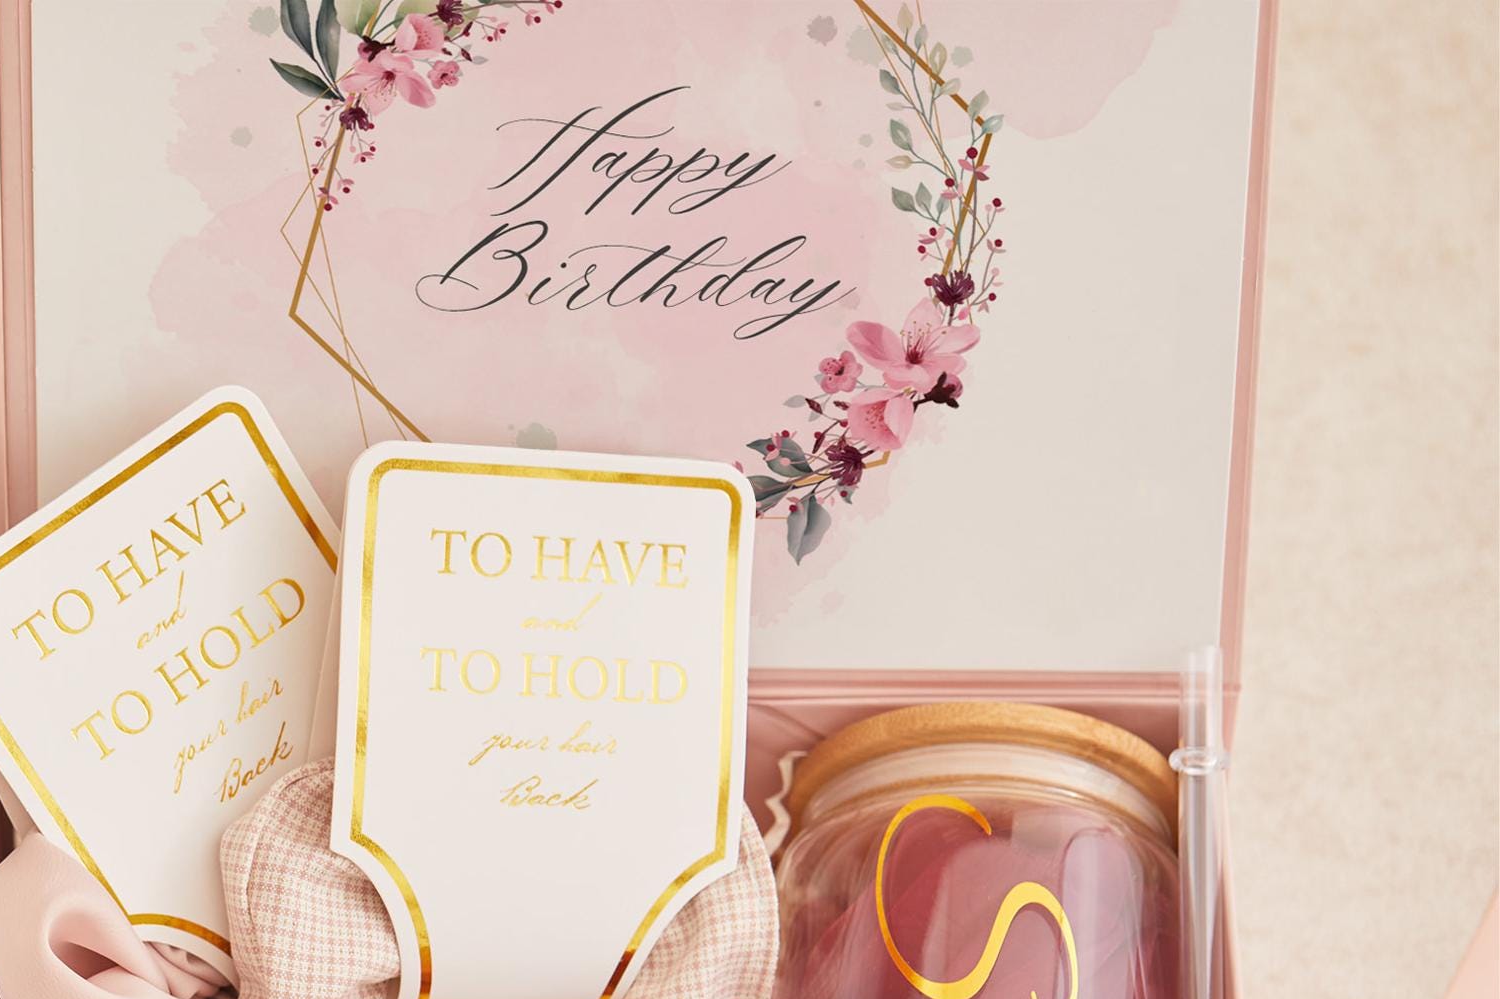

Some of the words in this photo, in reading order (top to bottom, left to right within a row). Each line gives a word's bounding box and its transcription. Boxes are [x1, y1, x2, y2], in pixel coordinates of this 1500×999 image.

[486, 85, 792, 218] Happy
[414, 218, 858, 341] Birthday
[11, 588, 95, 661] TO
[96, 479, 247, 604] HAVE
[430, 527, 513, 578] TO
[530, 535, 689, 589] HAVE
[136, 570, 188, 650] and
[520, 592, 603, 632] and
[70, 689, 154, 761] TO
[154, 577, 307, 706] HOLD
[419, 646, 501, 695] TO
[518, 652, 689, 705] HOLD
[173, 719, 228, 795] your
[235, 678, 284, 723] hair
[217, 720, 294, 803] Back
[467, 732, 550, 766] your
[558, 720, 617, 755] hair
[499, 775, 599, 810] Back
